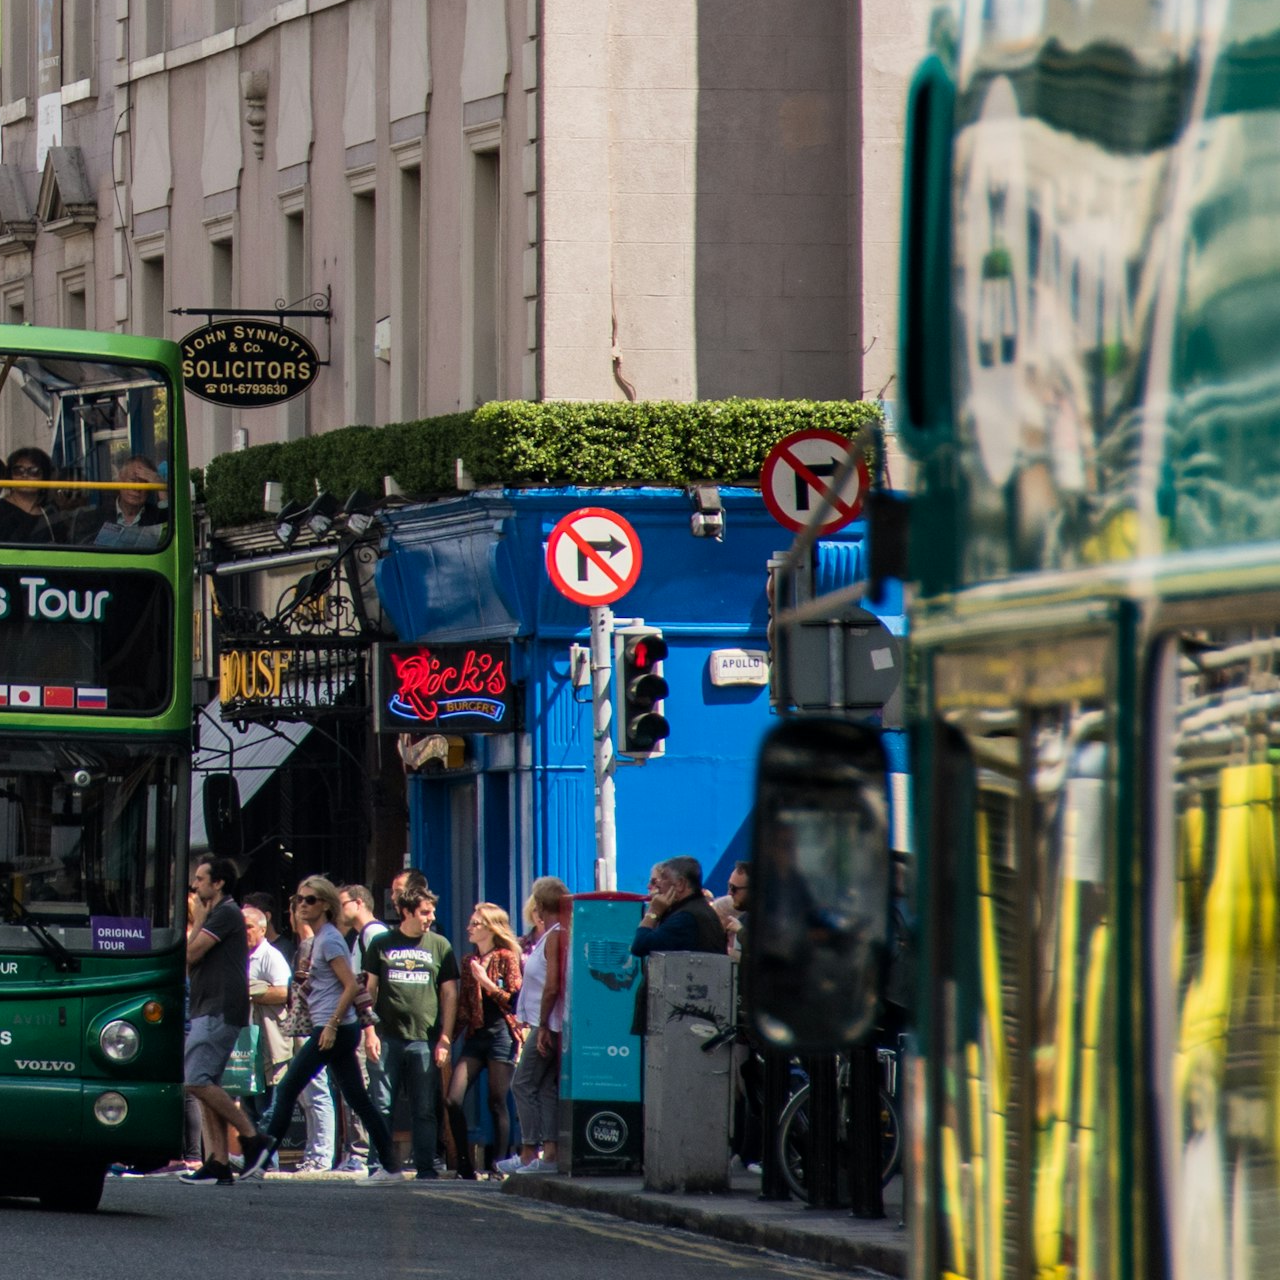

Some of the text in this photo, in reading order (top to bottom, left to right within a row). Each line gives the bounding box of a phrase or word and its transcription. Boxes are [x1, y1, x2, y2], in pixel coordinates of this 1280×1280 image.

[184, 325, 308, 359] JOHN SYNNOTT
[229, 342, 238, 353] &
[182, 360, 311, 380] SOLICITORS
[220, 383, 288, 395] 01-6793630
[19, 577, 111, 620] Tour
[721, 658, 760, 669] APOLLO
[390, 647, 507, 720] Rick's
[446, 697, 498, 715] BURGERS
[97, 927, 146, 939] ORIGINAL
[98, 940, 126, 951] TOUR
[388, 949, 433, 963] GUINNESS
[388, 971, 431, 981] IRELAND
[14, 1059, 76, 1071] VOLVO
